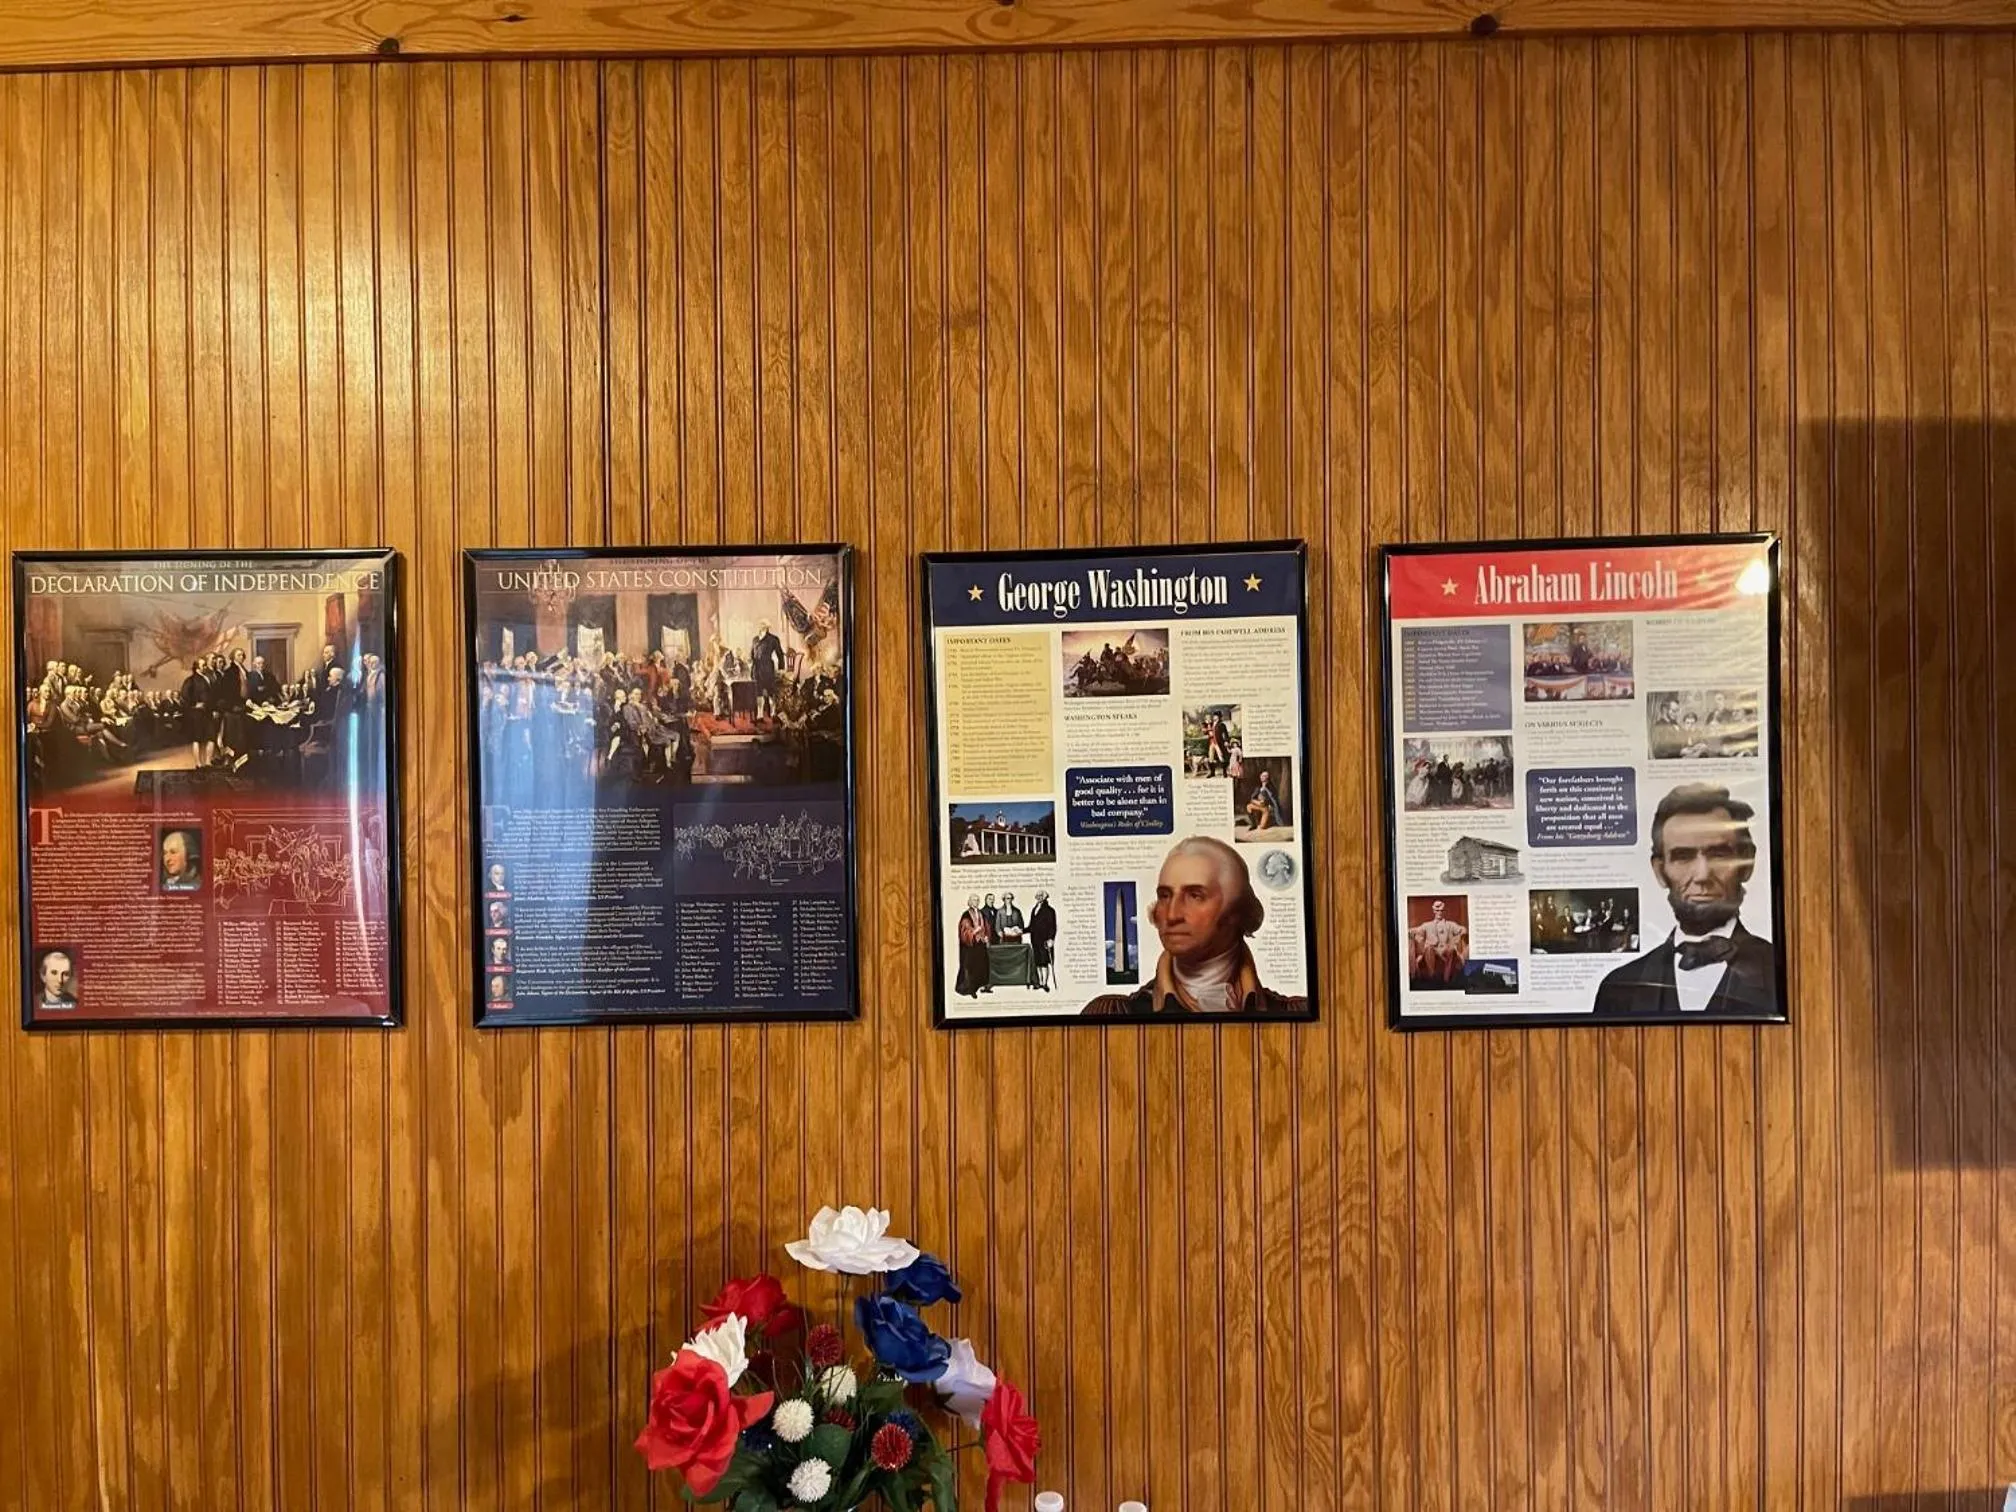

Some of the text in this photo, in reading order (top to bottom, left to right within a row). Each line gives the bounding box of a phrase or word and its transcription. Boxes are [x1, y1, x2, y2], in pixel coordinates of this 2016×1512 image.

[30, 571, 381, 594] DECLARATION OF INDEPENDENCE
[497, 567, 823, 591] UNITED STATES CONSTITUTION
[1473, 560, 1678, 606] Abraham Lincoln
[997, 566, 1228, 619] George Washington
[1115, 773, 1134, 783] with
[1153, 773, 1164, 782] of
[1074, 786, 1094, 798] good
[1094, 785, 1122, 798] quality
